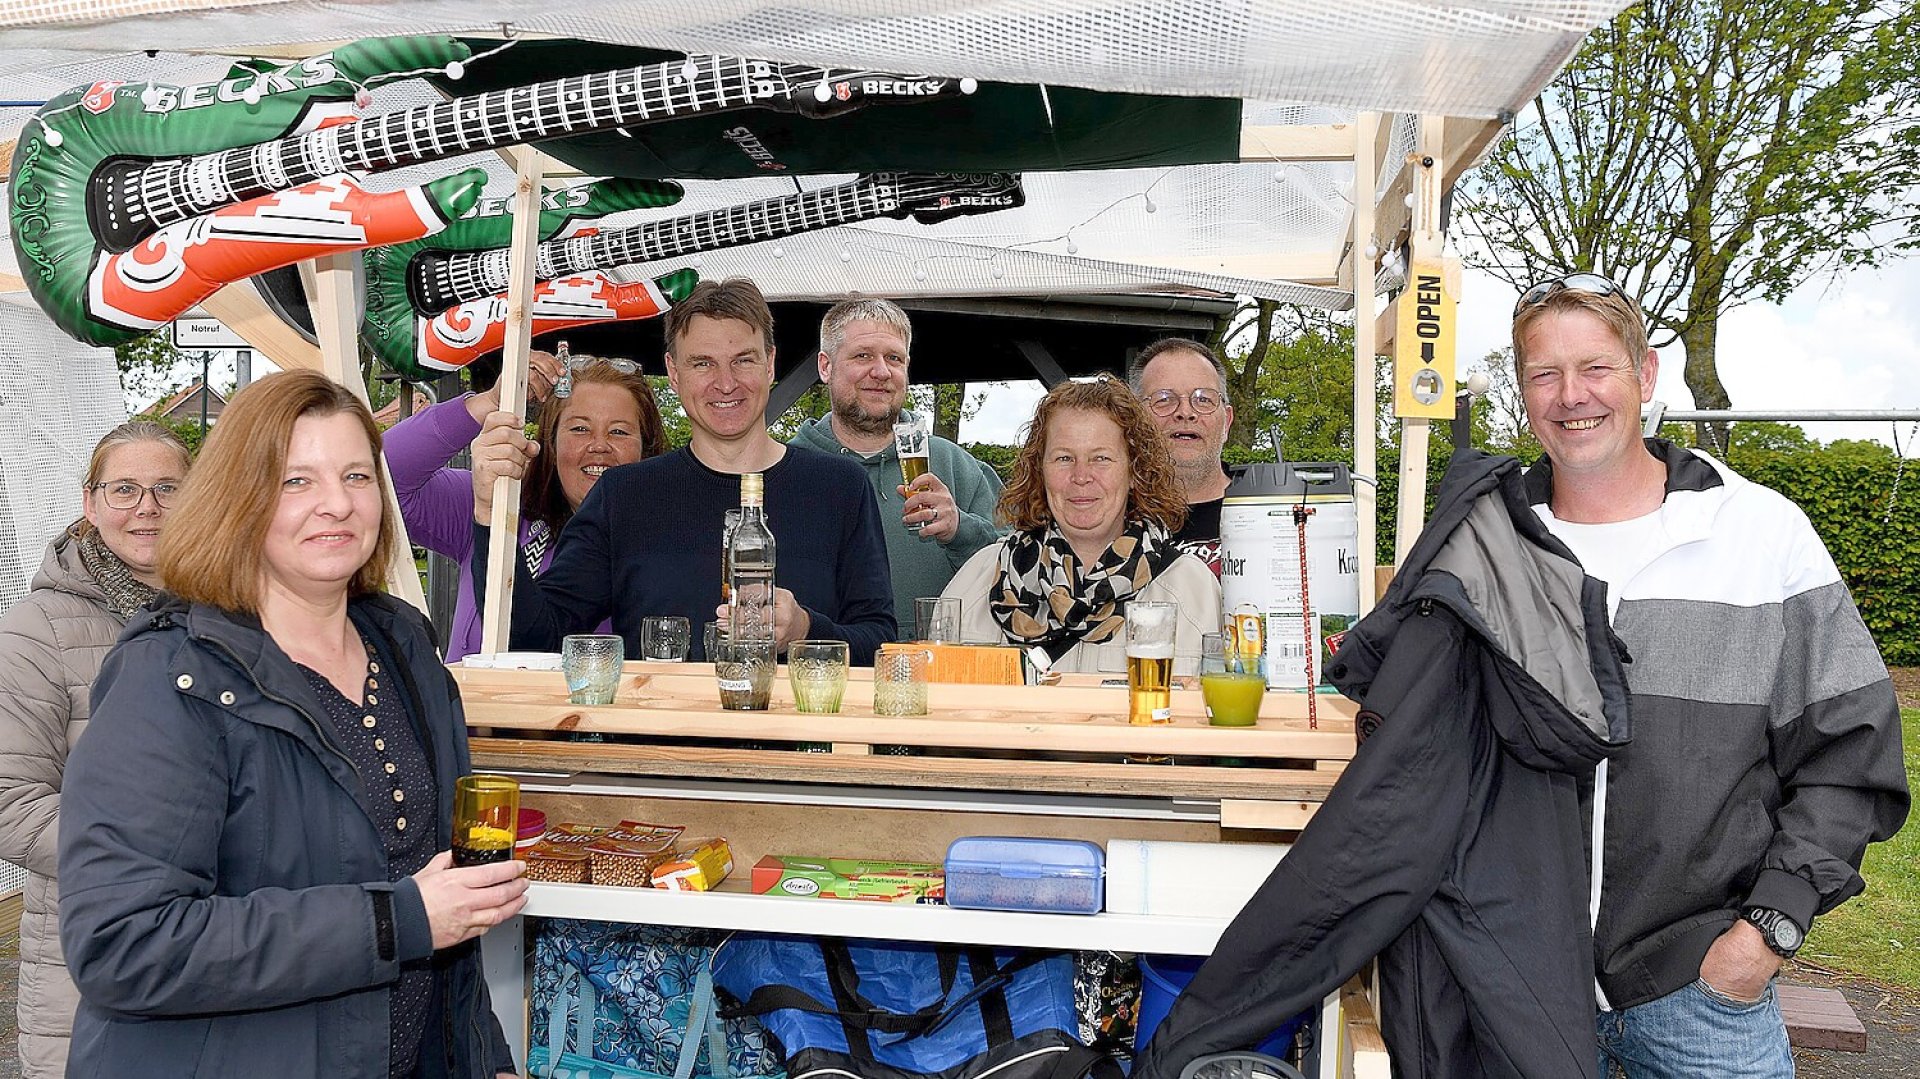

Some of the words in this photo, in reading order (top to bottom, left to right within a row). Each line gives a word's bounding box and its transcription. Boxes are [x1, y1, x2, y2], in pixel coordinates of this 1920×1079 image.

[862, 80, 941, 96] BECK'S
[1416, 274, 1441, 338] OPEN
[191, 324, 220, 333] Notruf
[1222, 550, 1246, 576] cher
